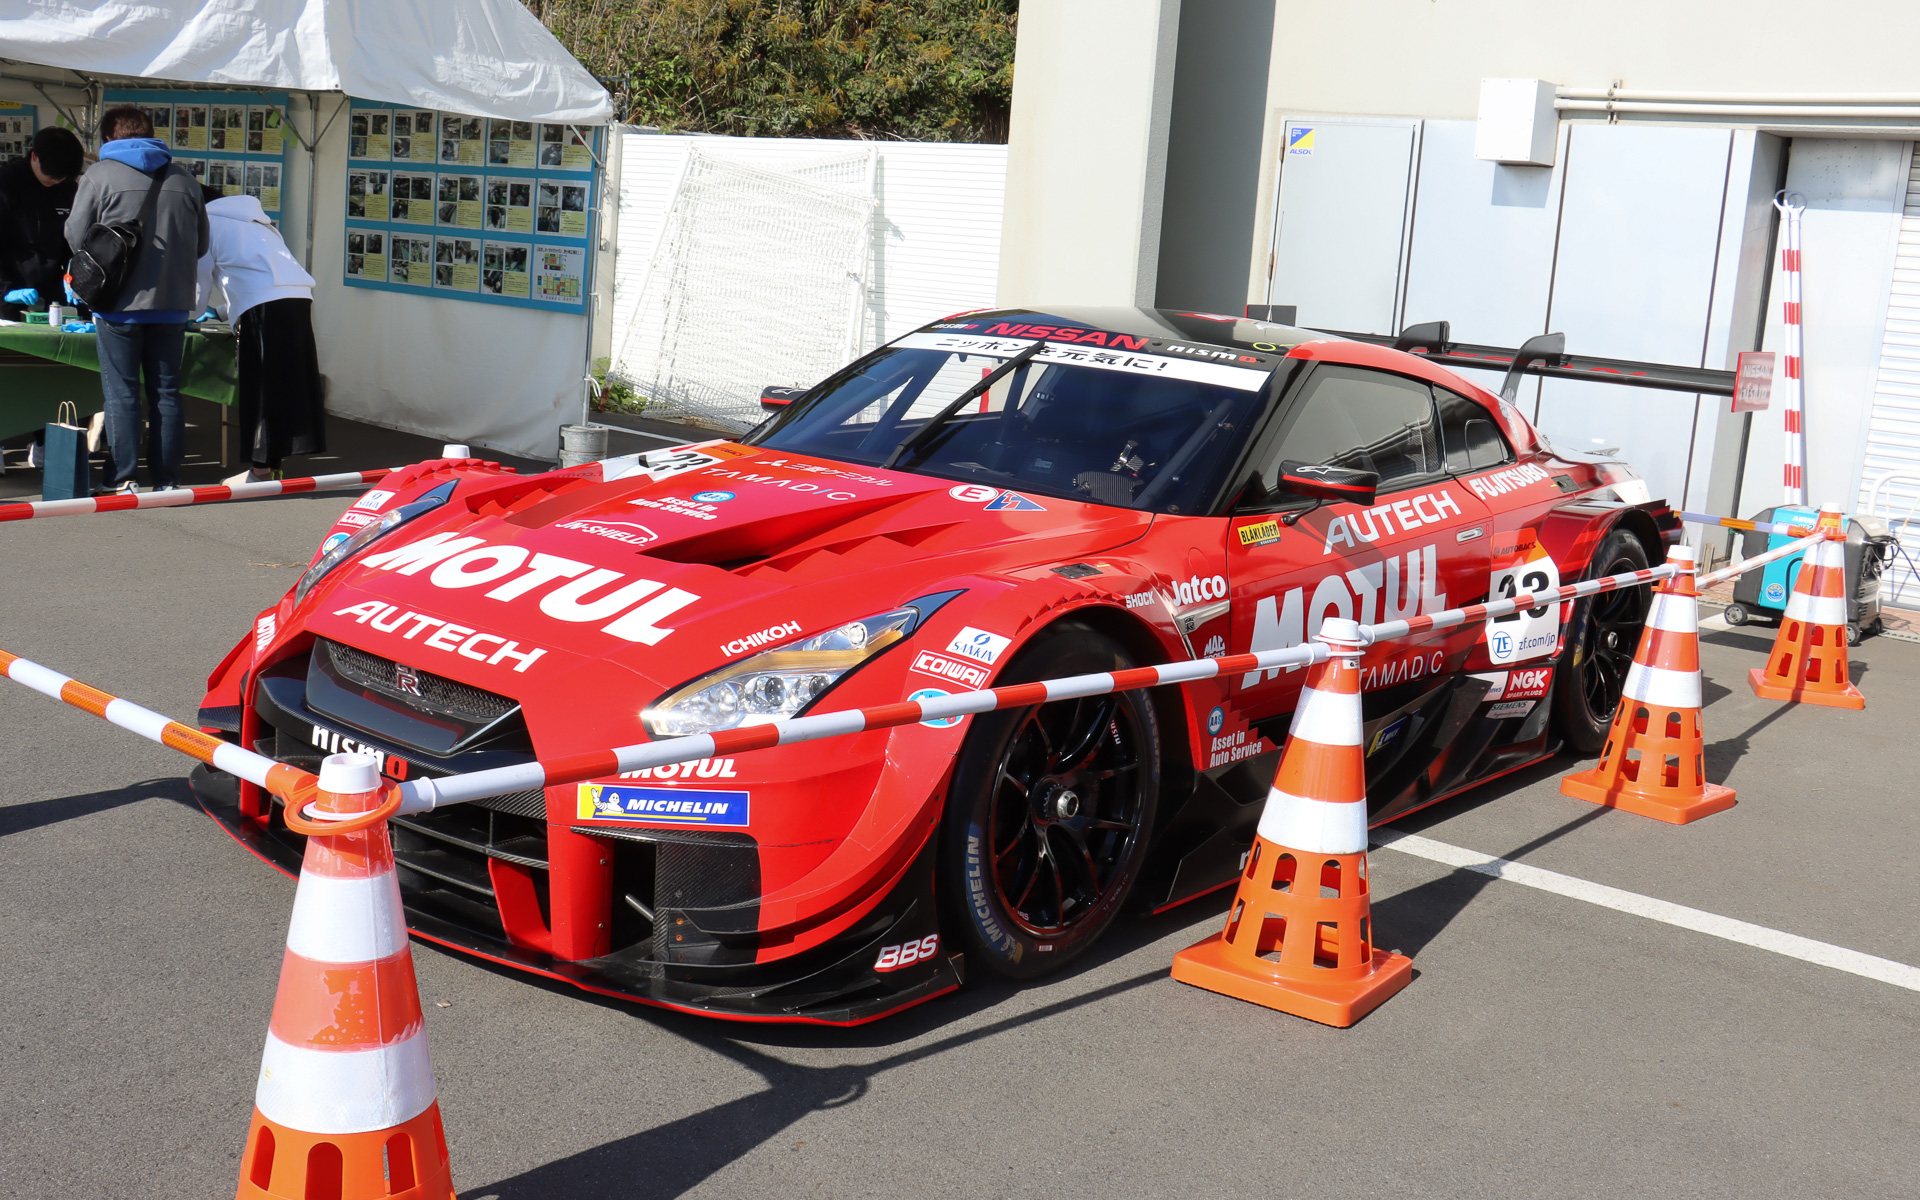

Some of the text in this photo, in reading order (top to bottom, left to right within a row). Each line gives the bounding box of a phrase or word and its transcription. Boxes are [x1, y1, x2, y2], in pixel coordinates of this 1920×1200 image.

[984, 322, 1150, 350] NISSAN
[1166, 344, 1257, 363] nismo
[1743, 364, 1771, 378] NISSAN
[700, 468, 857, 501] TAMADIC
[783, 463, 893, 486] 三菱ケミカル
[1468, 461, 1550, 501] FUJITSUBO
[627, 498, 718, 520] Auto Service
[657, 496, 718, 512] Asset in
[1240, 523, 1279, 543] BLÅKLÄDER
[1322, 489, 1462, 555] AUTECH
[1500, 541, 1537, 555] AUTOBACS
[358, 532, 702, 646] MOTUL
[1125, 590, 1156, 609] SHOCK
[1171, 574, 1227, 606] Jatco
[1493, 570, 1550, 624] 23
[1241, 543, 1447, 691] MOTUL
[332, 600, 548, 673] AUTECH
[719, 620, 802, 657] ICHIKOH
[1203, 634, 1226, 656] MAC
[1493, 635, 1513, 654] ZF
[1519, 632, 1556, 651] zf.com/jp
[950, 640, 996, 663] SANKIN
[920, 656, 985, 685] KOIWAI
[1509, 669, 1549, 691] NGK
[1524, 689, 1543, 697] PLUGS
[1491, 701, 1529, 711] SIEMENS
[1209, 713, 1222, 727] AAS
[1211, 730, 1246, 752] Asset in
[311, 725, 408, 781] nismo
[1209, 741, 1263, 768] Auto Service
[626, 798, 729, 815] MICHELIN
[967, 835, 1004, 943] MICHELIN
[874, 933, 940, 970] BBS
